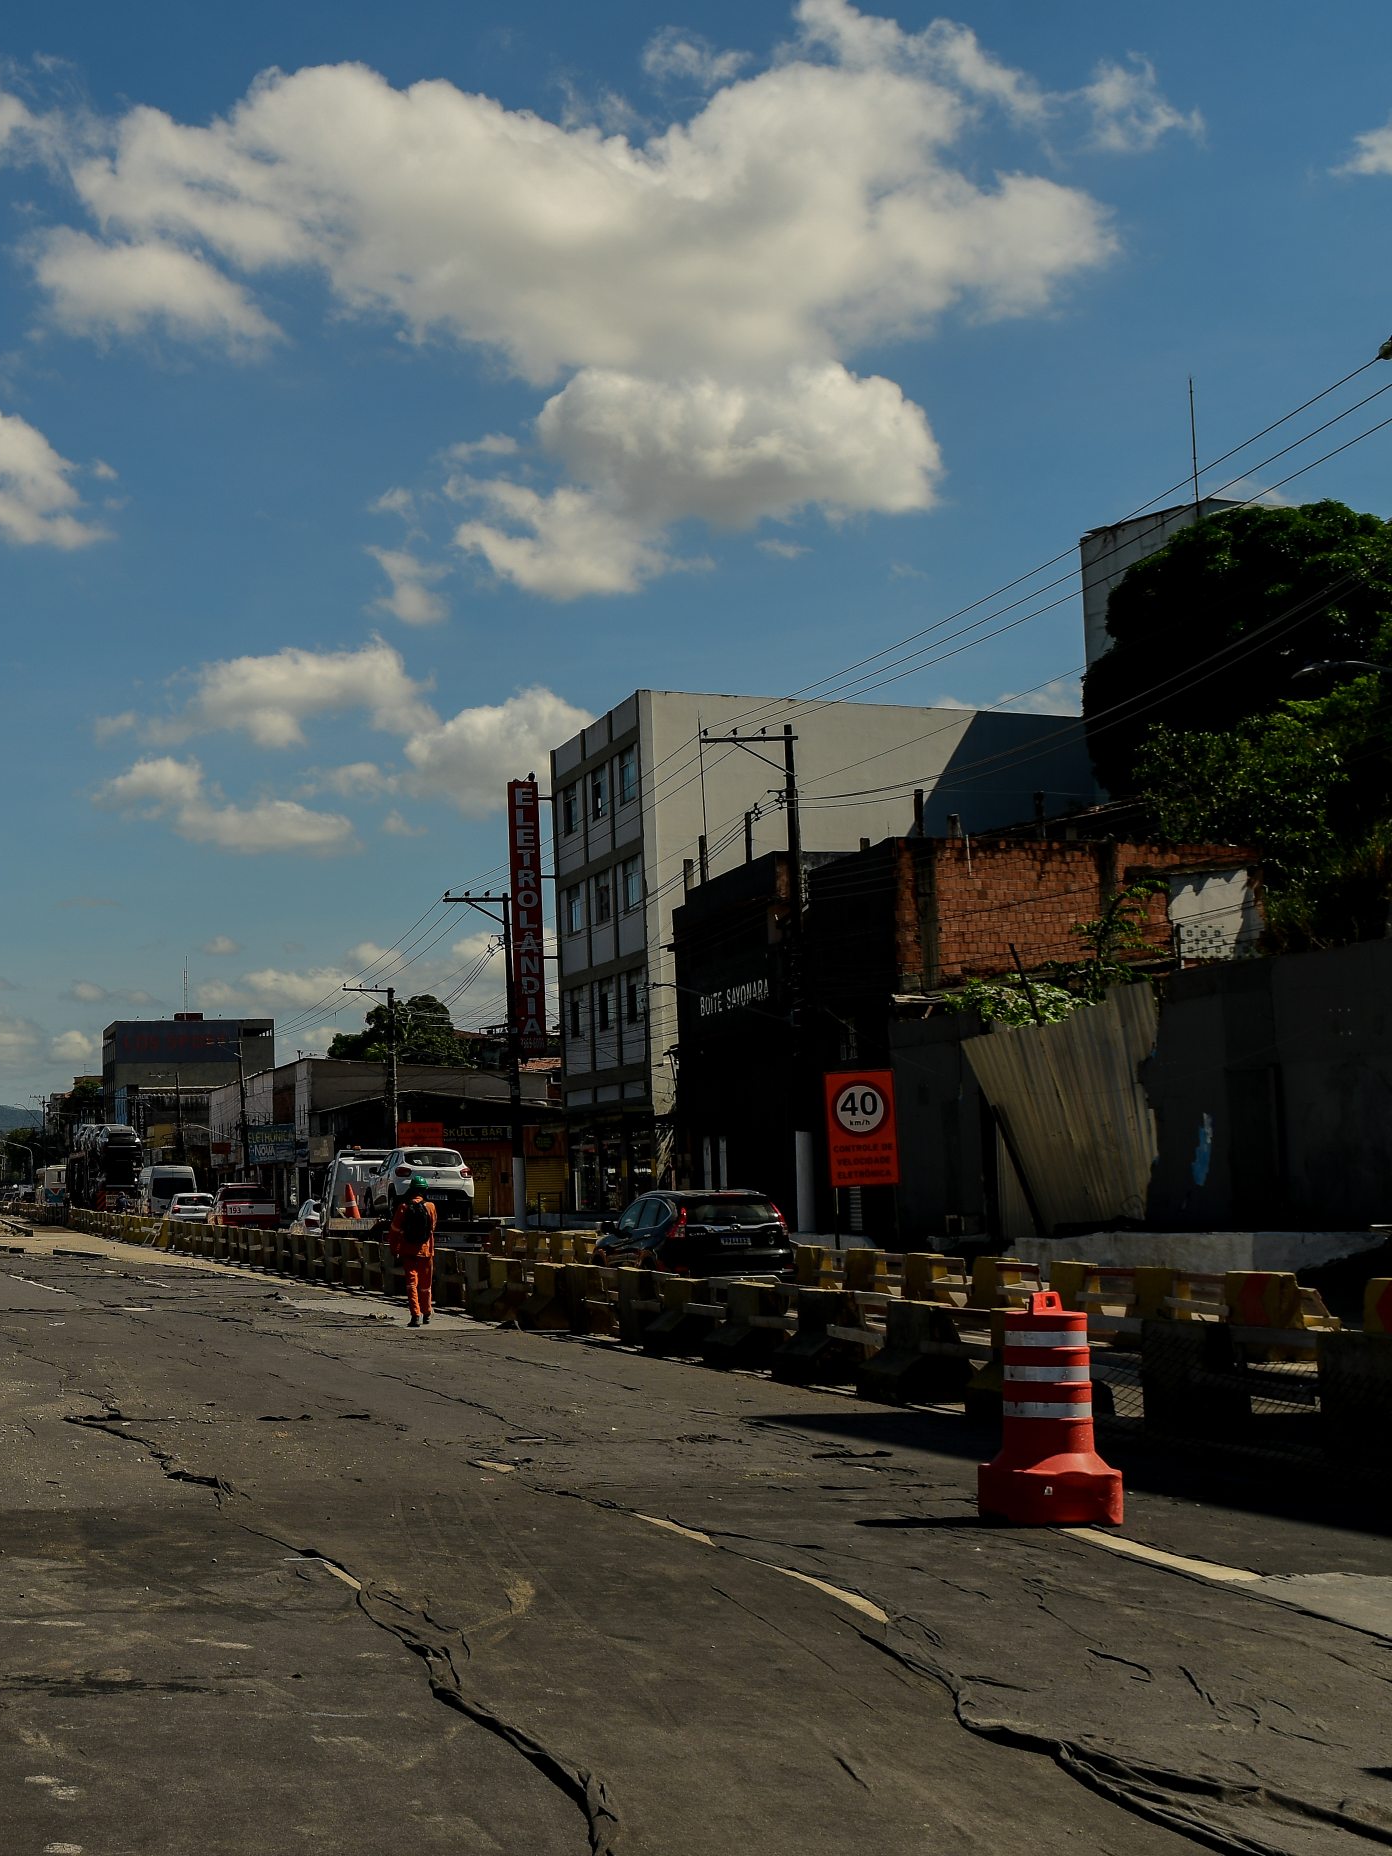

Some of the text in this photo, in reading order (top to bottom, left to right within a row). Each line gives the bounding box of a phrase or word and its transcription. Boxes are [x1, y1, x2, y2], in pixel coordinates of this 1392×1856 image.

[514, 787, 542, 1036] ELETROLÂNDIA
[726, 978, 769, 1009] SAYONARA
[840, 1091, 878, 1116] 40
[443, 1128, 475, 1137] SKULL
[481, 1128, 503, 1136] BAR
[833, 1143, 893, 1153] CONTROLE DE
[836, 1156, 891, 1166] VELOCIDADE
[229, 1206, 241, 1215] 193
